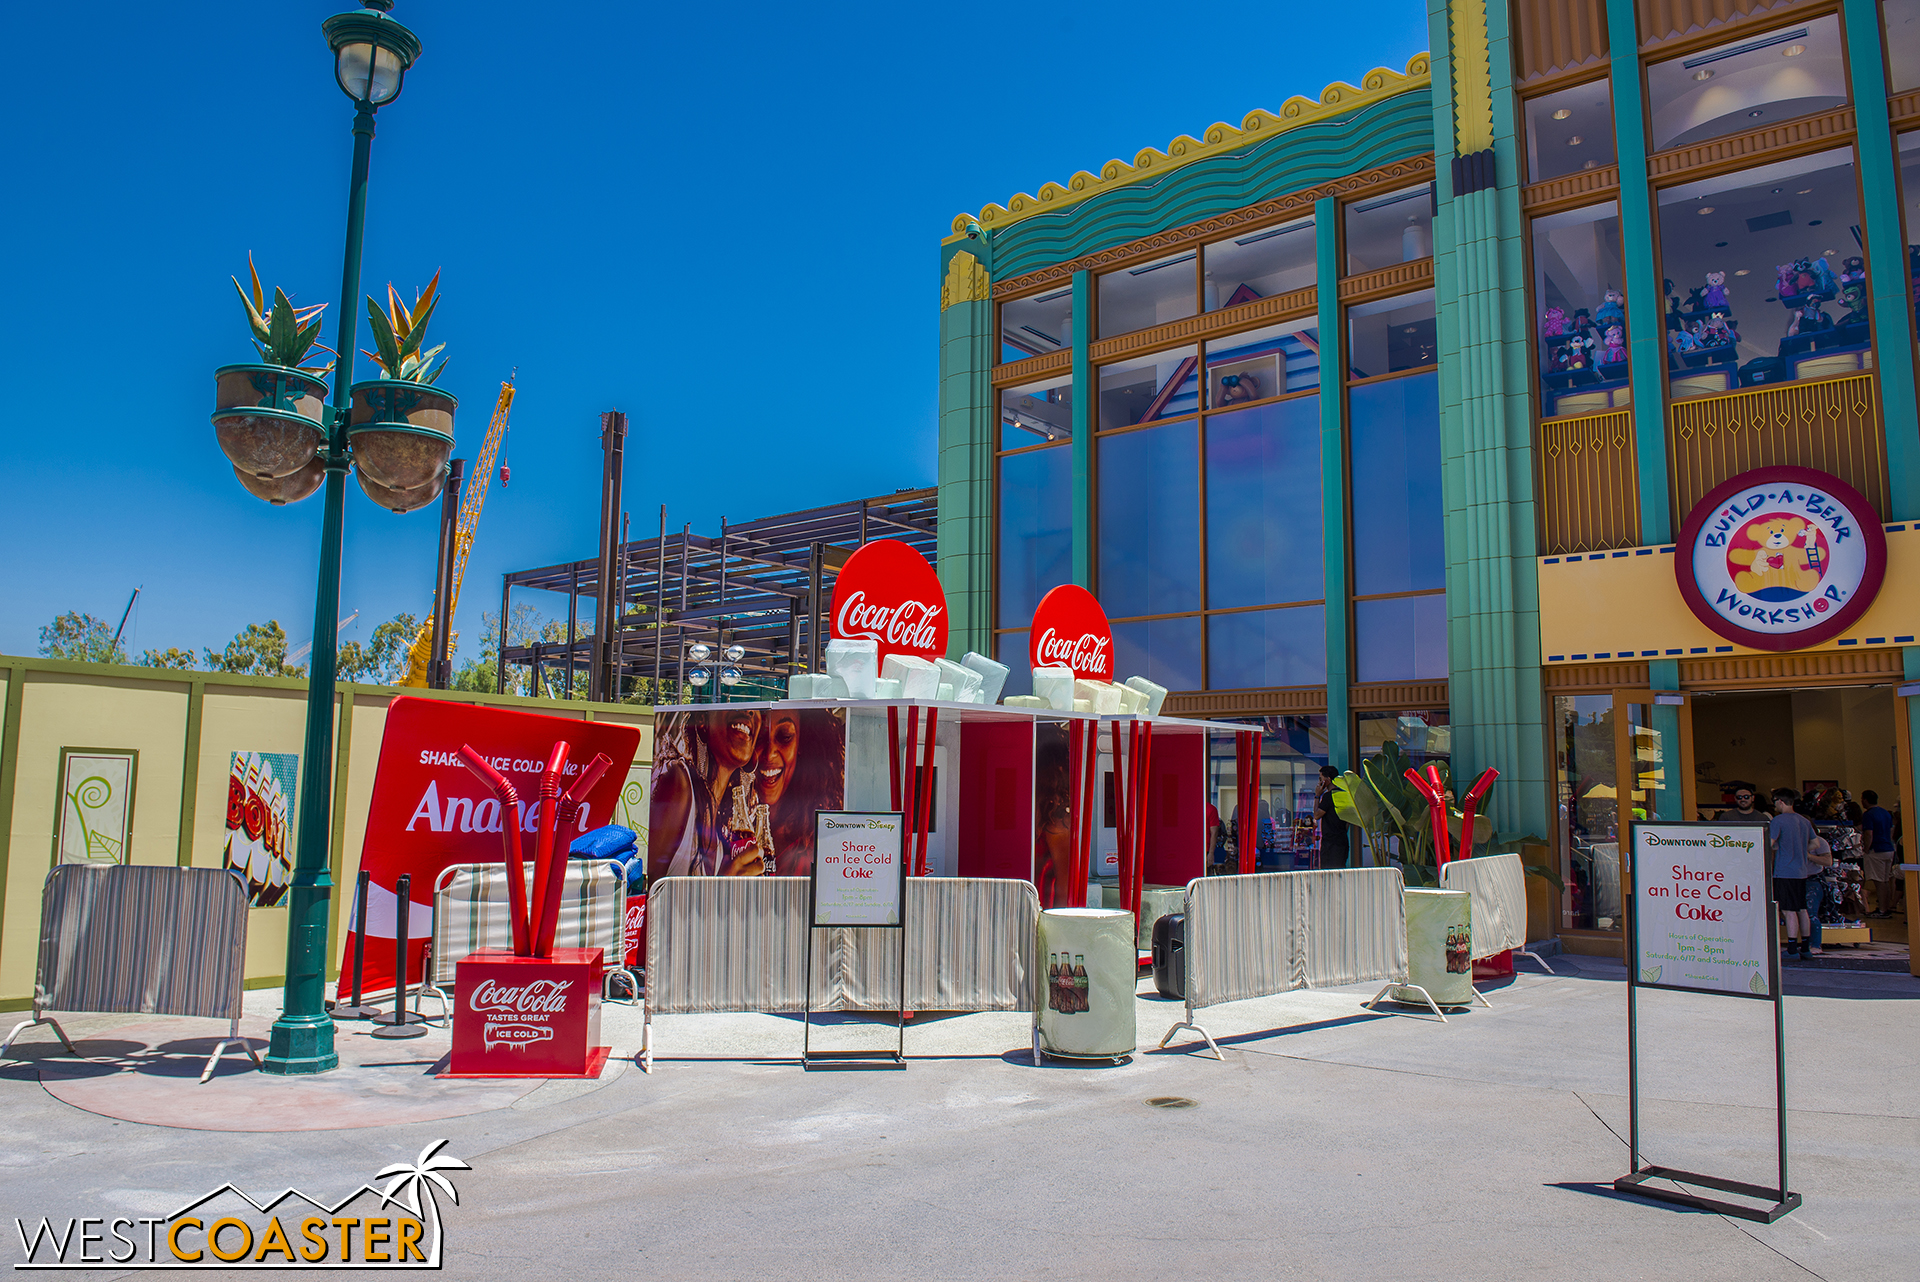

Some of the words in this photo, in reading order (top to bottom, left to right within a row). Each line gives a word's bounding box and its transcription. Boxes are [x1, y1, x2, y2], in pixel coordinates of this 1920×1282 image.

[837, 590, 943, 650] Coca-Cola
[1036, 627, 1110, 674] Coca-Cola
[490, 757, 511, 771] ICE
[513, 759, 544, 773] COLD
[405, 779, 591, 833] Anae
[841, 840, 876, 852] Share
[824, 855, 840, 864] an
[843, 853, 861, 864] Ice
[863, 853, 892, 865] Cold
[842, 866, 874, 879] Coke
[1671, 864, 1725, 882] Share
[1648, 886, 1669, 897] an
[1675, 882, 1702, 899] Ice
[1707, 884, 1751, 902] Cold
[1675, 902, 1723, 922] Coke
[1668, 932, 1688, 940] Hours
[1689, 932, 1696, 940] of
[1677, 942, 1695, 953] 1pm
[1703, 944, 1725, 955] 8pm
[1680, 954, 1696, 962] 6/17
[1742, 959, 1760, 968] 6/18
[469, 978, 575, 1012] Coca-Cola
[486, 1013, 519, 1022] TASTES
[520, 1013, 550, 1022] GREAT
[495, 1030, 512, 1038] ICE
[513, 1030, 539, 1038] COLD
